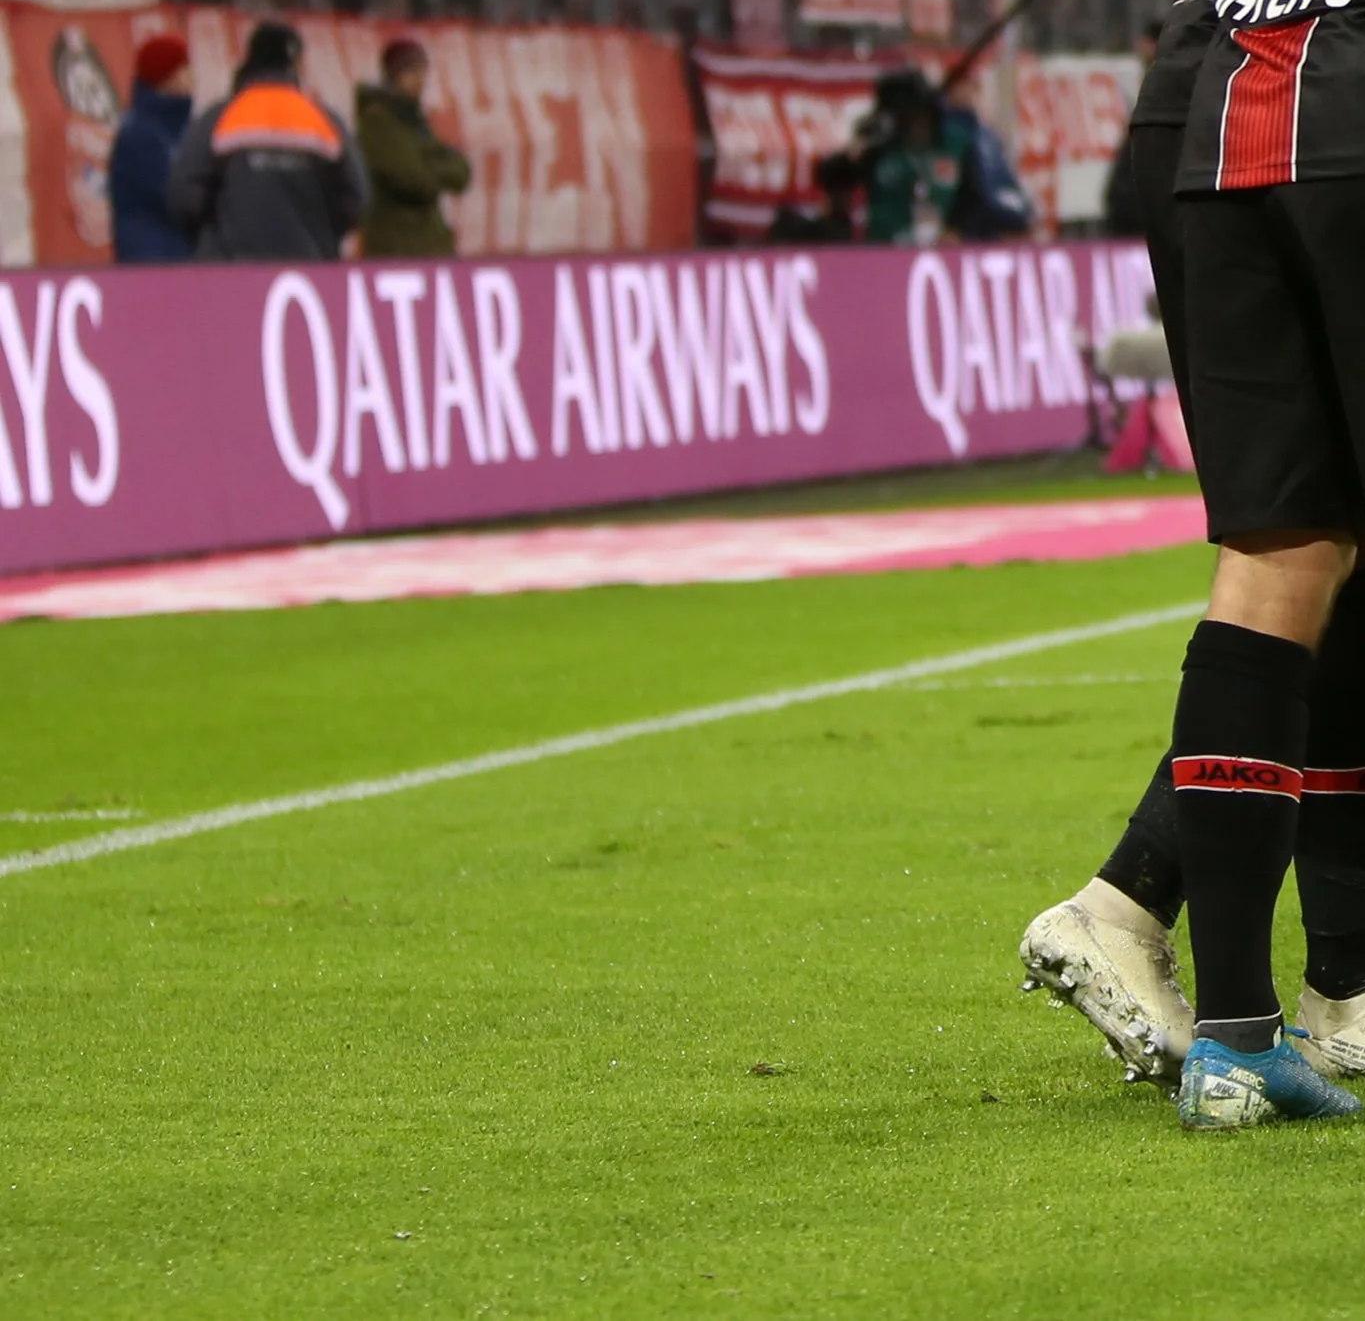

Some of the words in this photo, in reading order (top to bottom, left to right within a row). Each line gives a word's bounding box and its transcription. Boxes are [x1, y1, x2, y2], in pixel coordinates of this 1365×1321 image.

[261, 268, 539, 531] QATAR
[551, 254, 830, 456] AIRWAYS
[907, 249, 1087, 458] QATAR
[1192, 762, 1281, 786] JAKO
